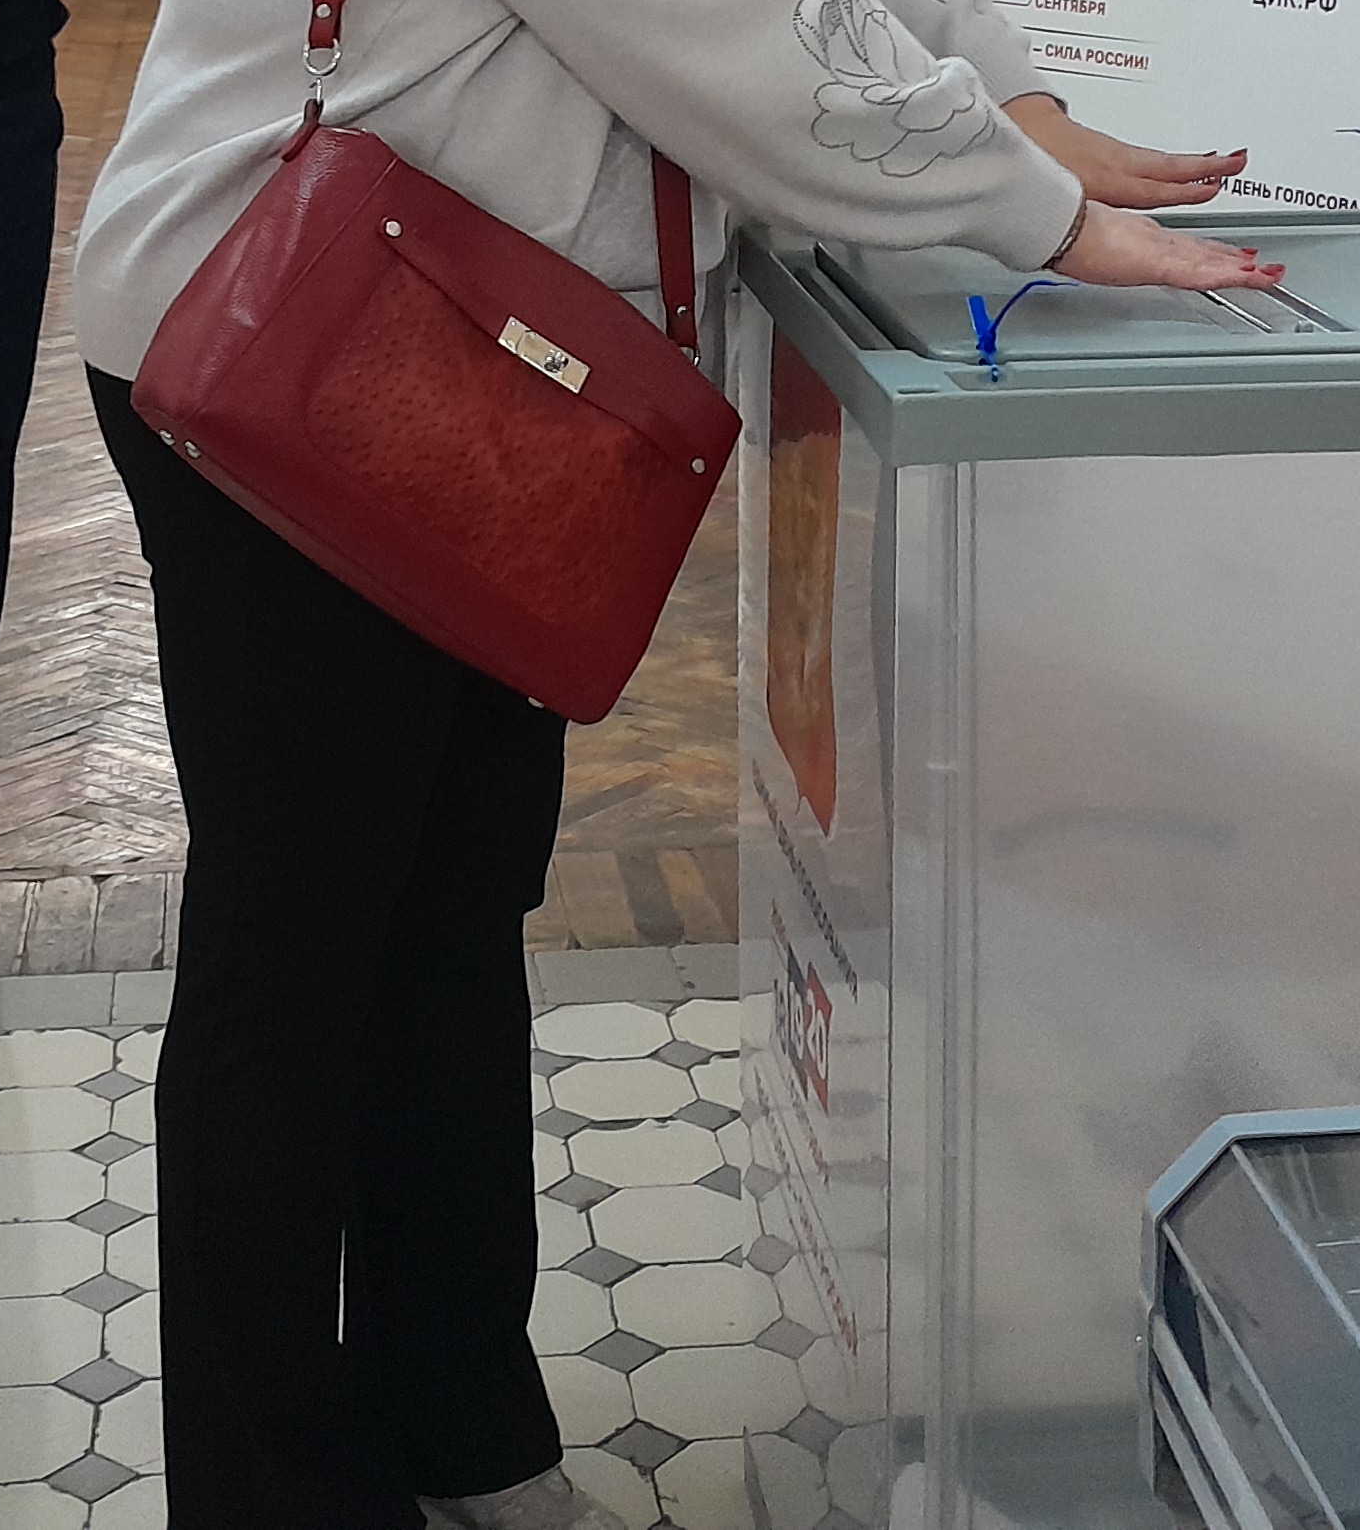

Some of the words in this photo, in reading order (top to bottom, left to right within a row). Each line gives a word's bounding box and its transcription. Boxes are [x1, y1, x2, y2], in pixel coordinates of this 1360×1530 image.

[1045, 44, 1081, 61] СИЛА
[1086, 49, 1148, 70] РОССИИ!
[1232, 179, 1271, 199] ДЕНЬ
